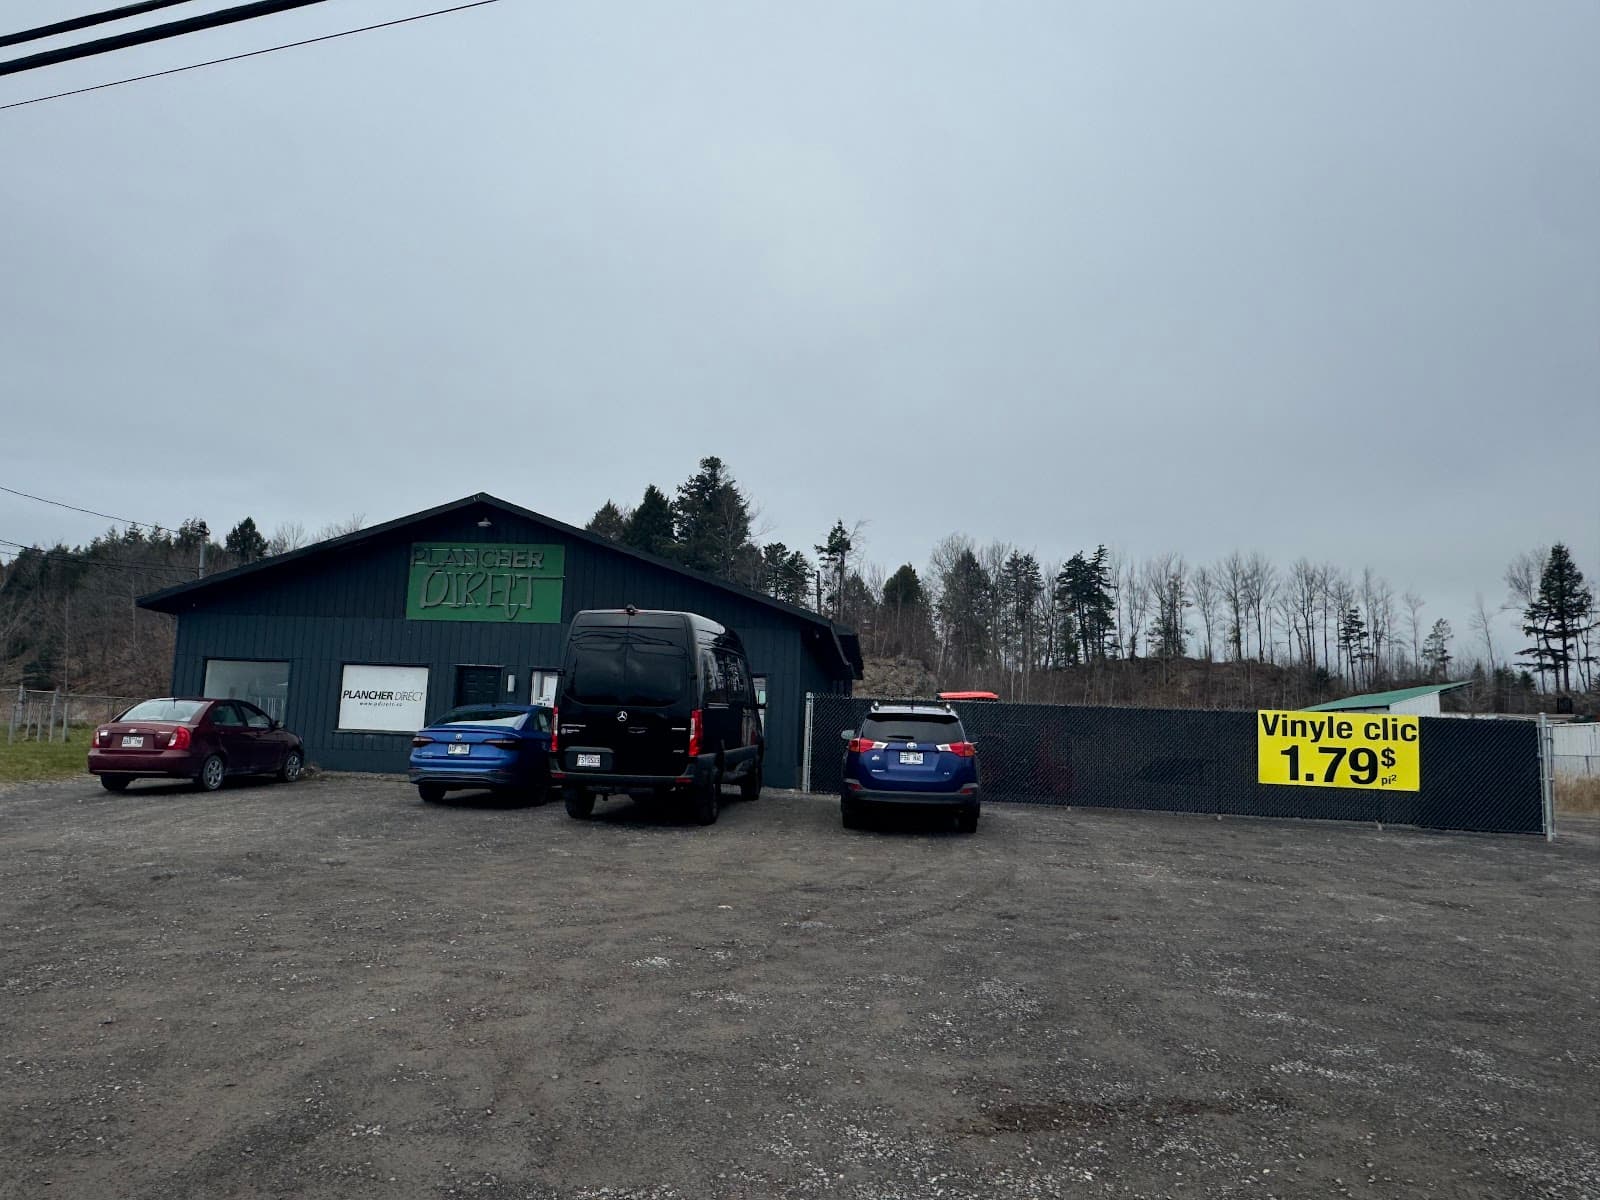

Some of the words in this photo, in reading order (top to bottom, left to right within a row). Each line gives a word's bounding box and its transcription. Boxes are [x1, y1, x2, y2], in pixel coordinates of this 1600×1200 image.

[410, 548, 544, 568] PLANCHER
[343, 690, 394, 700] PLANCHER
[394, 691, 423, 702] DIRECT
[1261, 713, 1353, 743] Vinyle
[1364, 718, 1418, 742] clic
